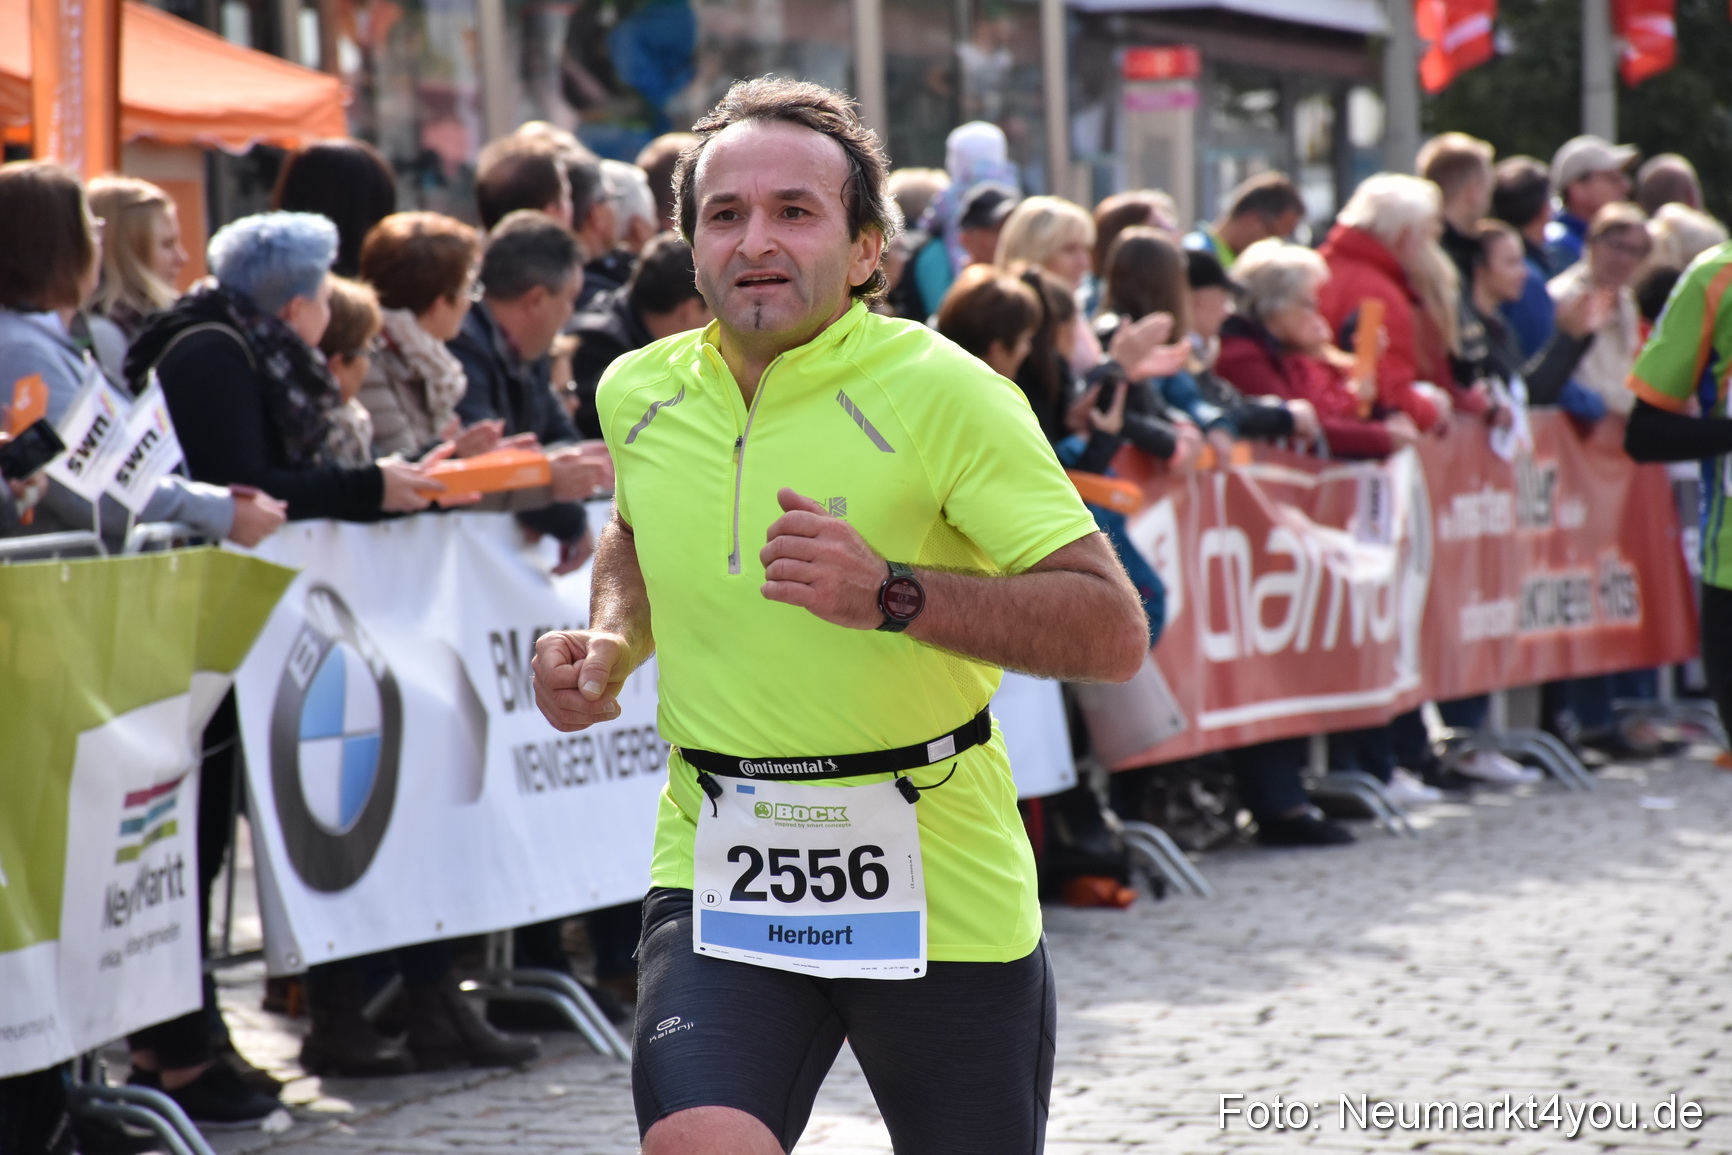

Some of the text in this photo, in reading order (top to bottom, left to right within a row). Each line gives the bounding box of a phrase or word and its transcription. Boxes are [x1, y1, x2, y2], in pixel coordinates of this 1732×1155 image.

[66, 414, 111, 477] swn
[114, 429, 160, 488] swn
[739, 759, 824, 777] Continental
[775, 803, 849, 822] BOCK
[798, 821, 806, 829] by
[727, 844, 890, 903] 2556
[706, 894, 715, 904] D
[768, 924, 853, 946] Herbert
